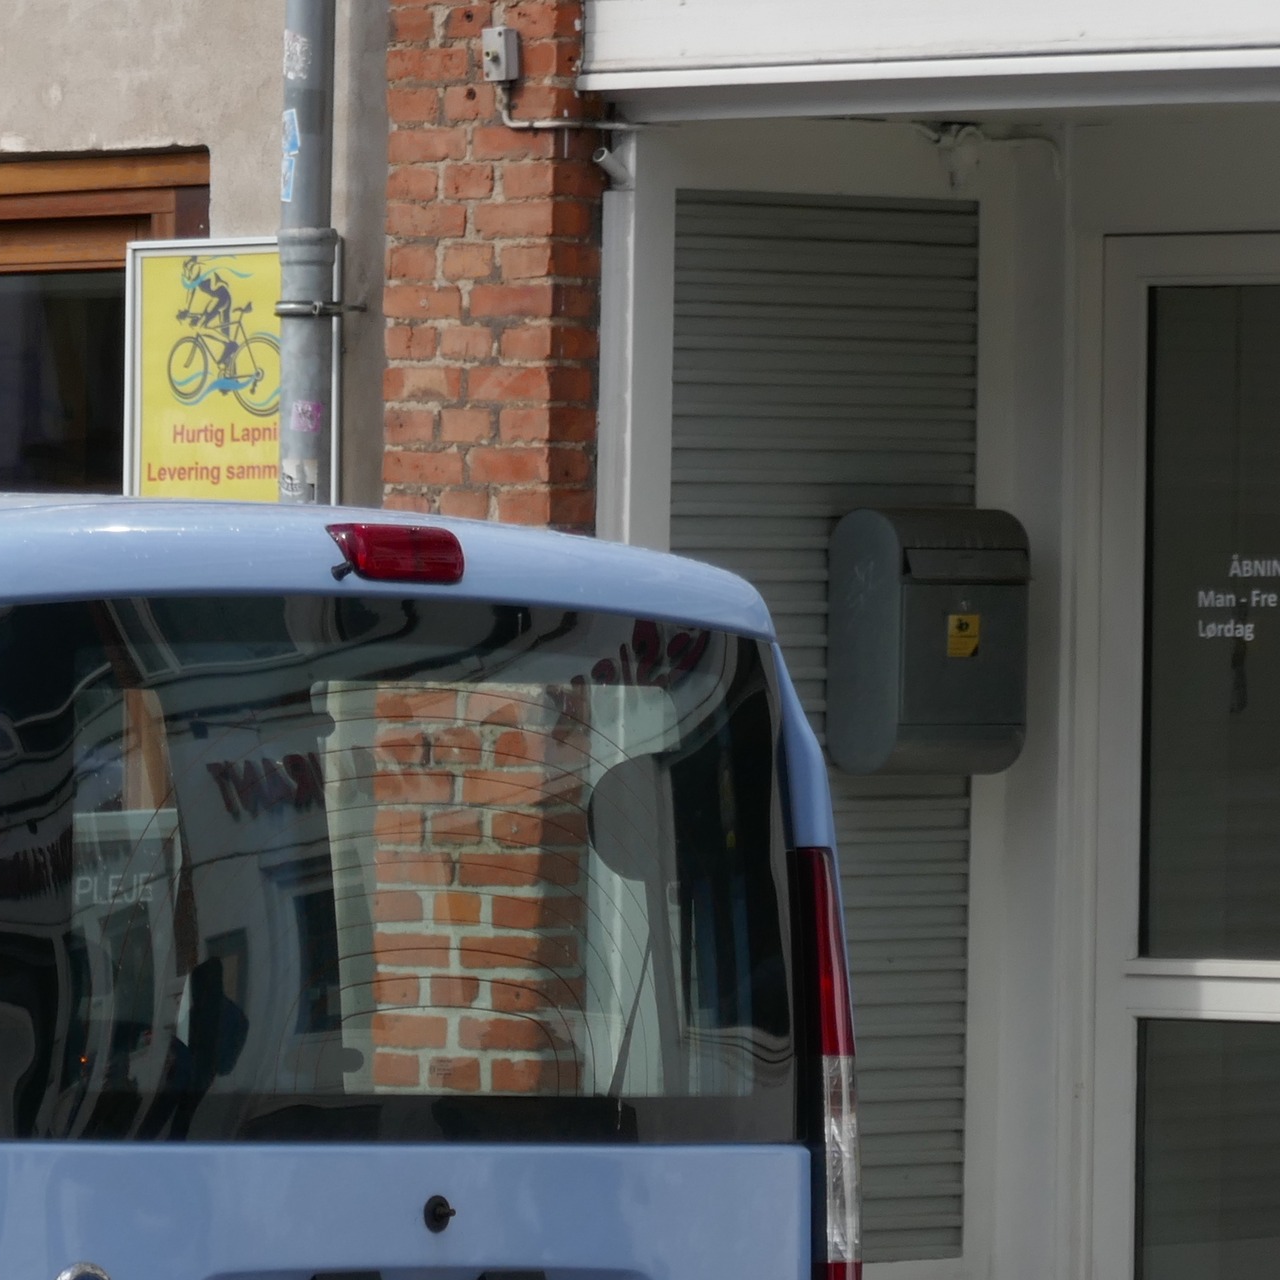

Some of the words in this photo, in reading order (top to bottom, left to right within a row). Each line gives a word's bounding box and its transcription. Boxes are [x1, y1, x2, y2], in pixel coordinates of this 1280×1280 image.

[173, 424, 224, 447] Hurtig
[231, 422, 278, 446] Lapni
[147, 462, 221, 485] Levering
[1198, 591, 1236, 608] Man
[1251, 590, 1278, 608] Fre
[1198, 620, 1255, 641] Lørdag
